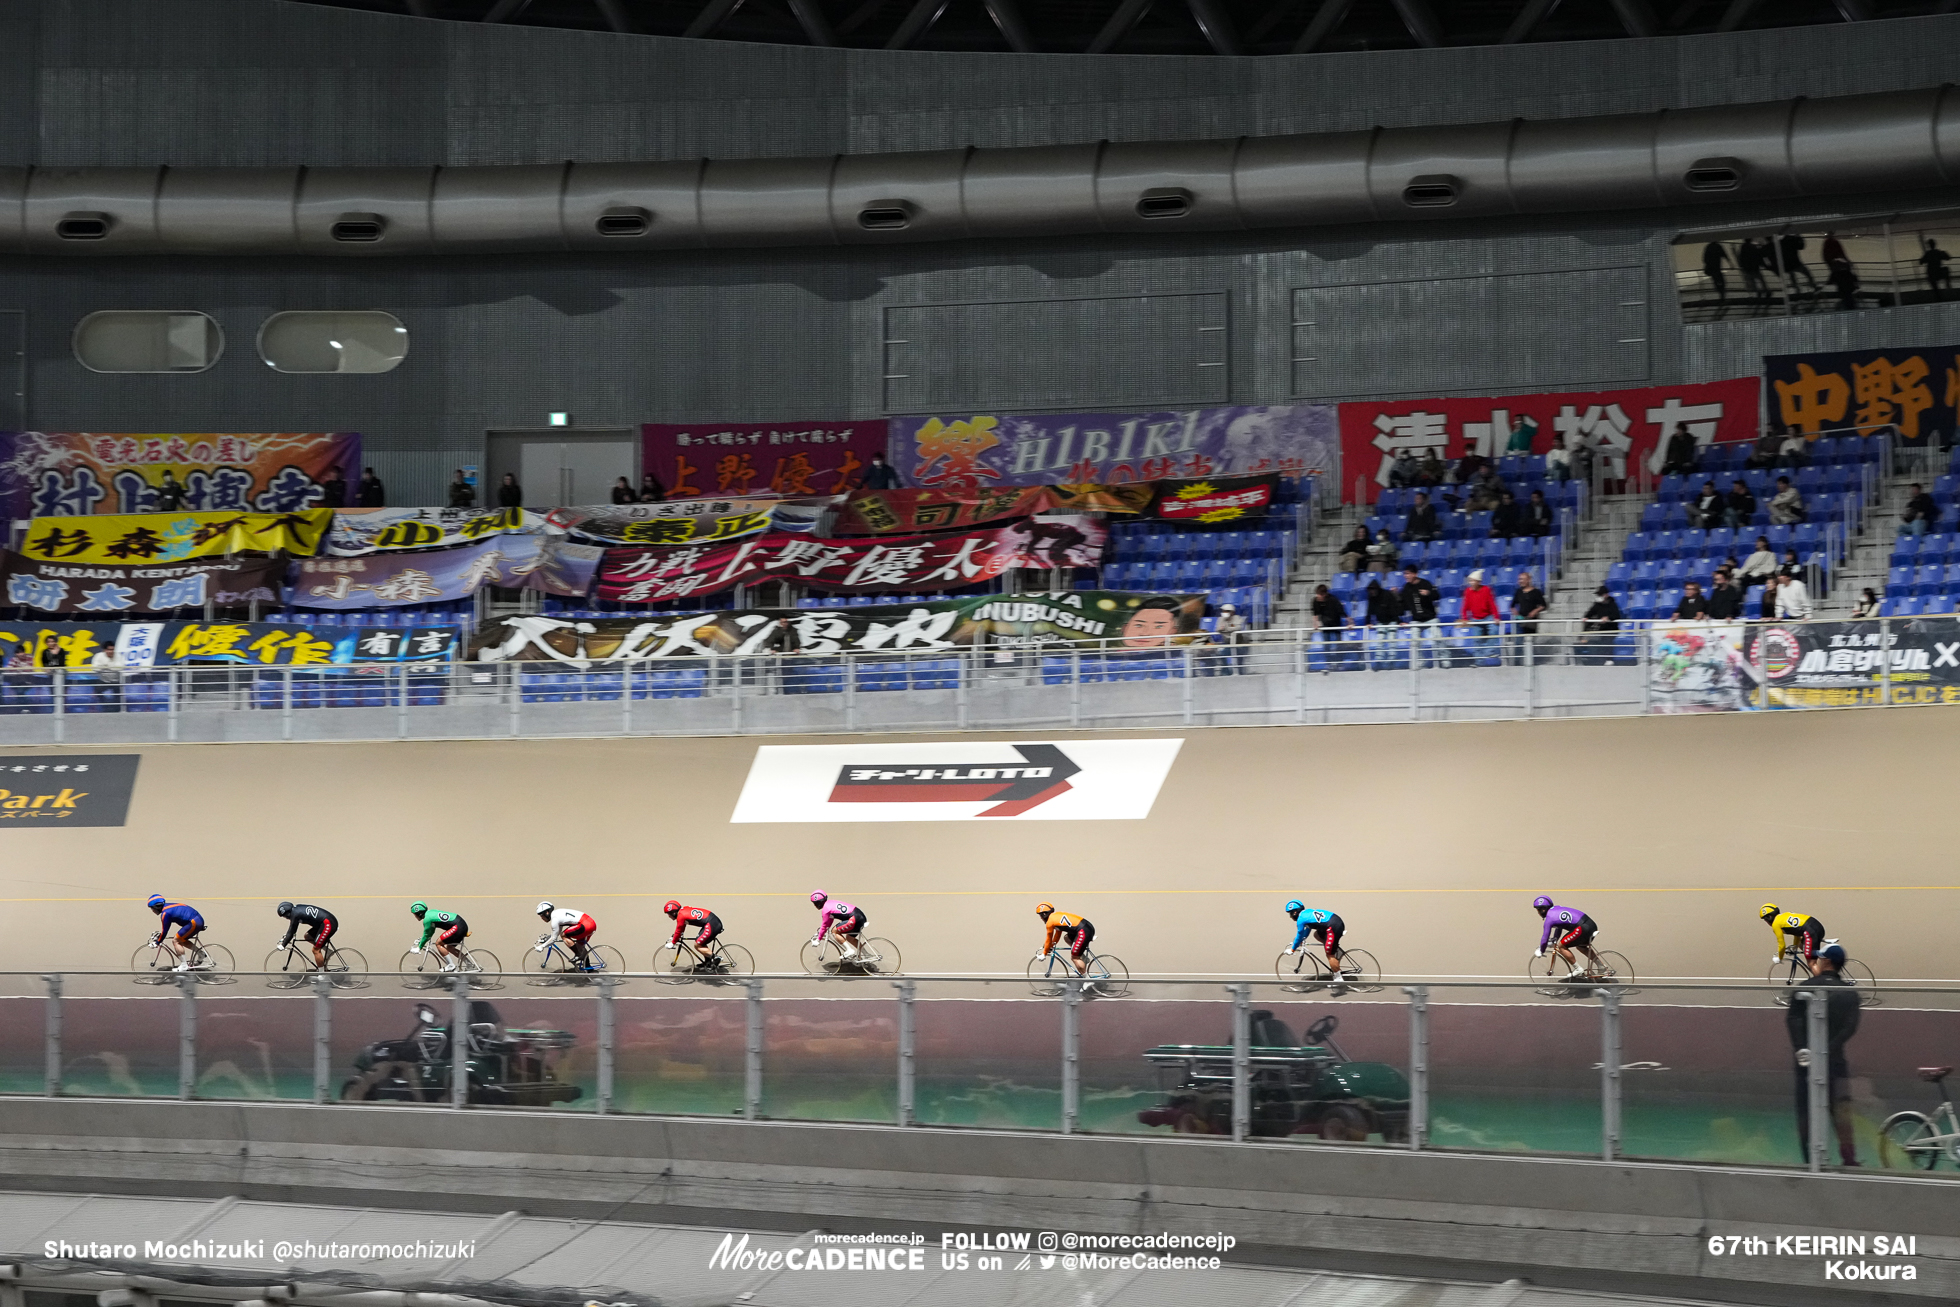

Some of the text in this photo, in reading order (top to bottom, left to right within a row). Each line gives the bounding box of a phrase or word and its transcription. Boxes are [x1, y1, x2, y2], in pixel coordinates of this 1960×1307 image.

[93, 435, 255, 466] 電光石火の差し
[716, 538, 1000, 588] 上野優太
[38, 565, 126, 580] HARADA
[972, 602, 1107, 635] INUBUSHI
[305, 905, 320, 919] 2
[565, 911, 576, 919] 1
[690, 908, 704, 920] 3
[836, 902, 848, 915] 8
[437, 911, 451, 923] 6
[1060, 914, 1073, 928] 7
[1313, 910, 1326, 924] 4
[1558, 910, 1573, 924] 9
[1786, 914, 1800, 928] 5
